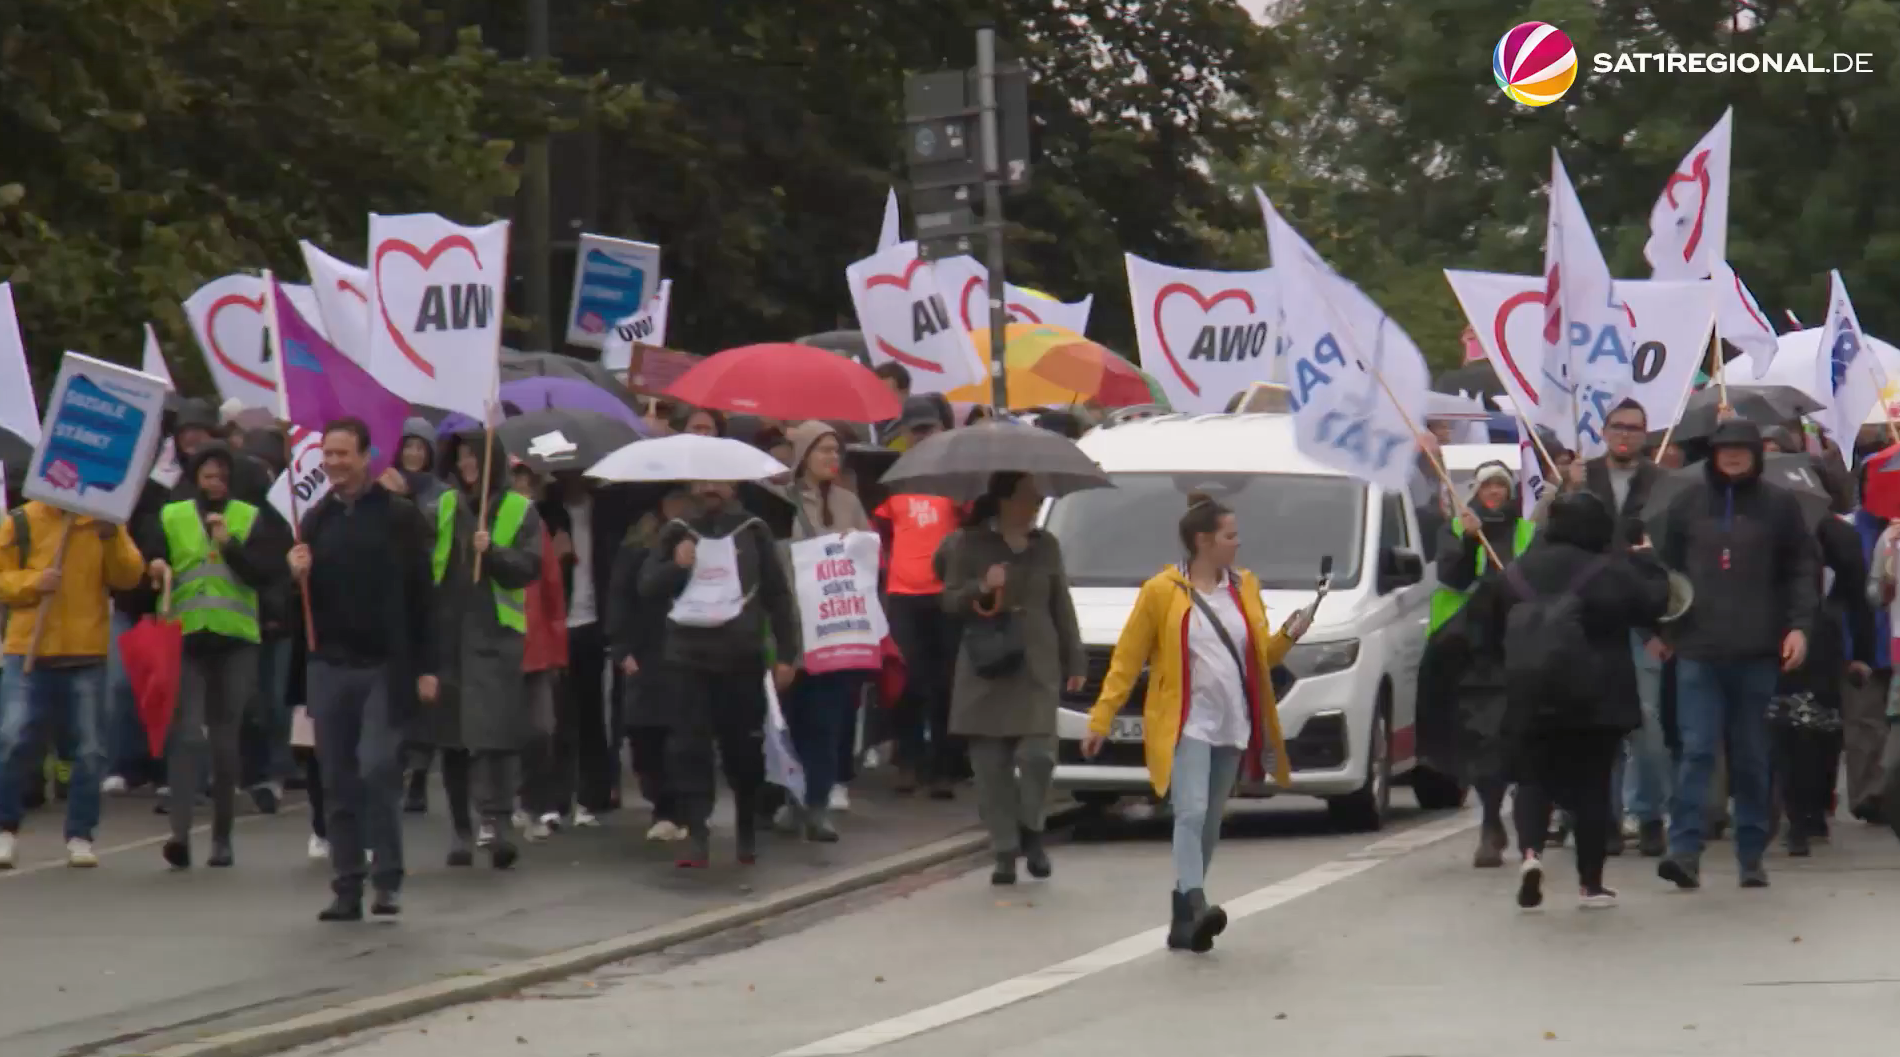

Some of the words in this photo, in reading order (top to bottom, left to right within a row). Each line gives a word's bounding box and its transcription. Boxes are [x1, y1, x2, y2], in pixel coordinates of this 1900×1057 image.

[414, 283, 493, 332] AW
[1188, 321, 1267, 362] AWO
[816, 559, 856, 580] Kitas
